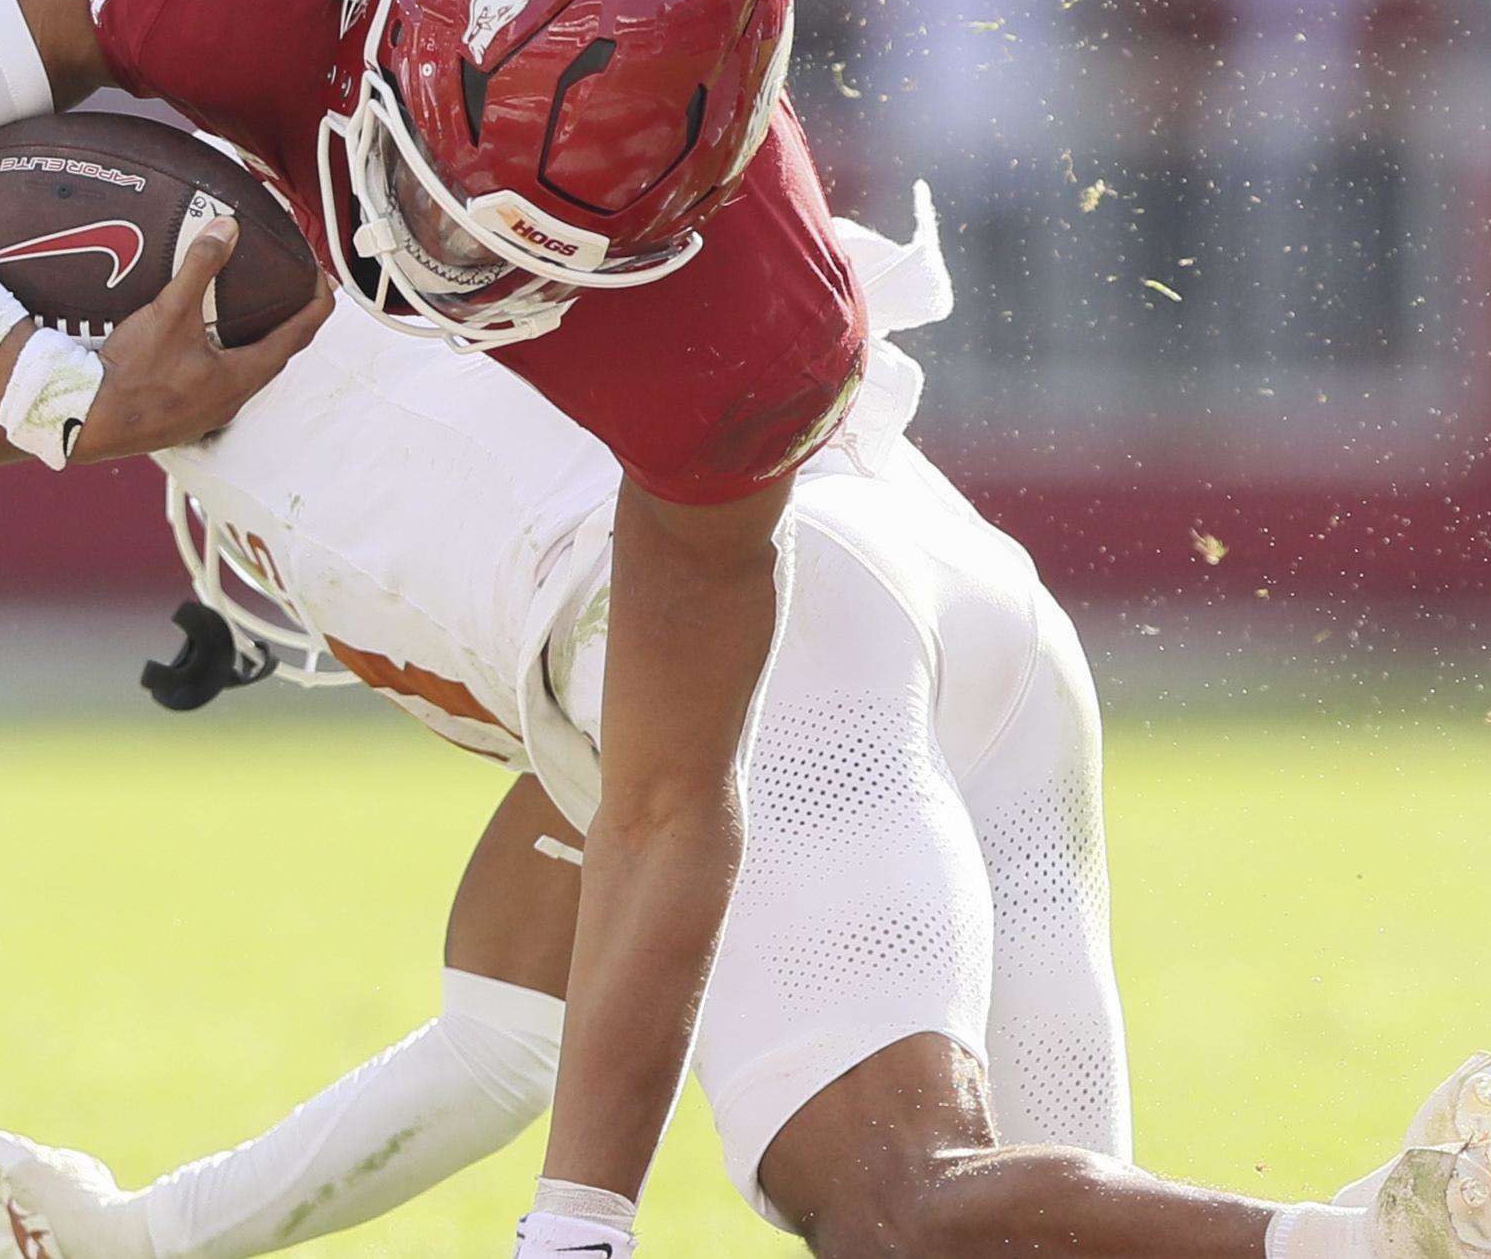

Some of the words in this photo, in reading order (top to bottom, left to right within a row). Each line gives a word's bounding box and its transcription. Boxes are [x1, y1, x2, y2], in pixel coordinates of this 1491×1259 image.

[0, 156, 65, 172] ELITE
[67, 160, 146, 192] VAPOR
[512, 219, 579, 256] HOGS
